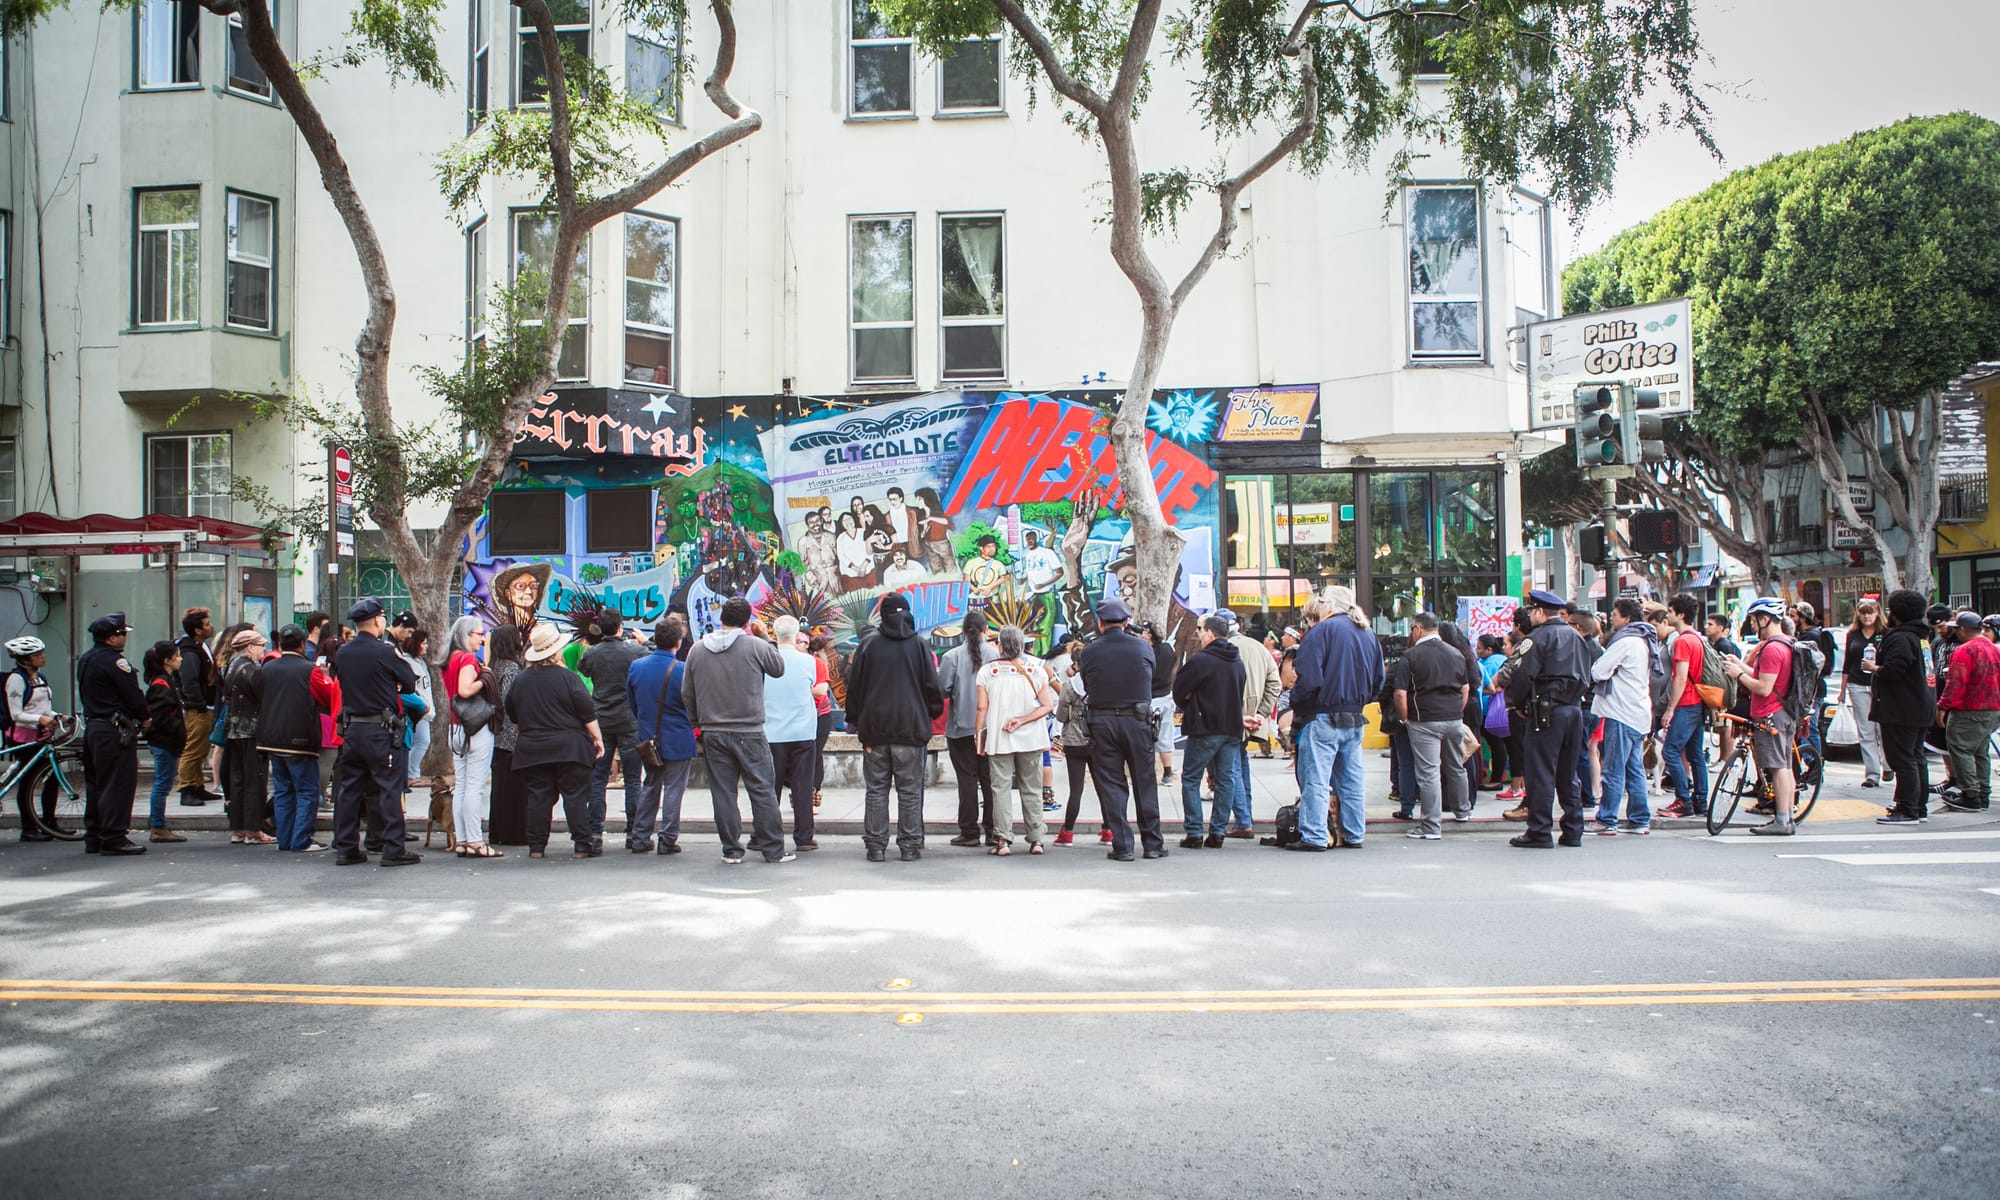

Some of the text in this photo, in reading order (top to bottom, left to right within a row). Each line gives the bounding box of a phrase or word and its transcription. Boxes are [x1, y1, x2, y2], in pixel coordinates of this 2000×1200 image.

[1584, 320, 1637, 345] Philz
[1585, 341, 1677, 375] Coffee
[1643, 376, 1652, 387] A
[1653, 373, 1678, 385] TIME
[1247, 407, 1300, 429] Place
[808, 478, 834, 489] Mission
